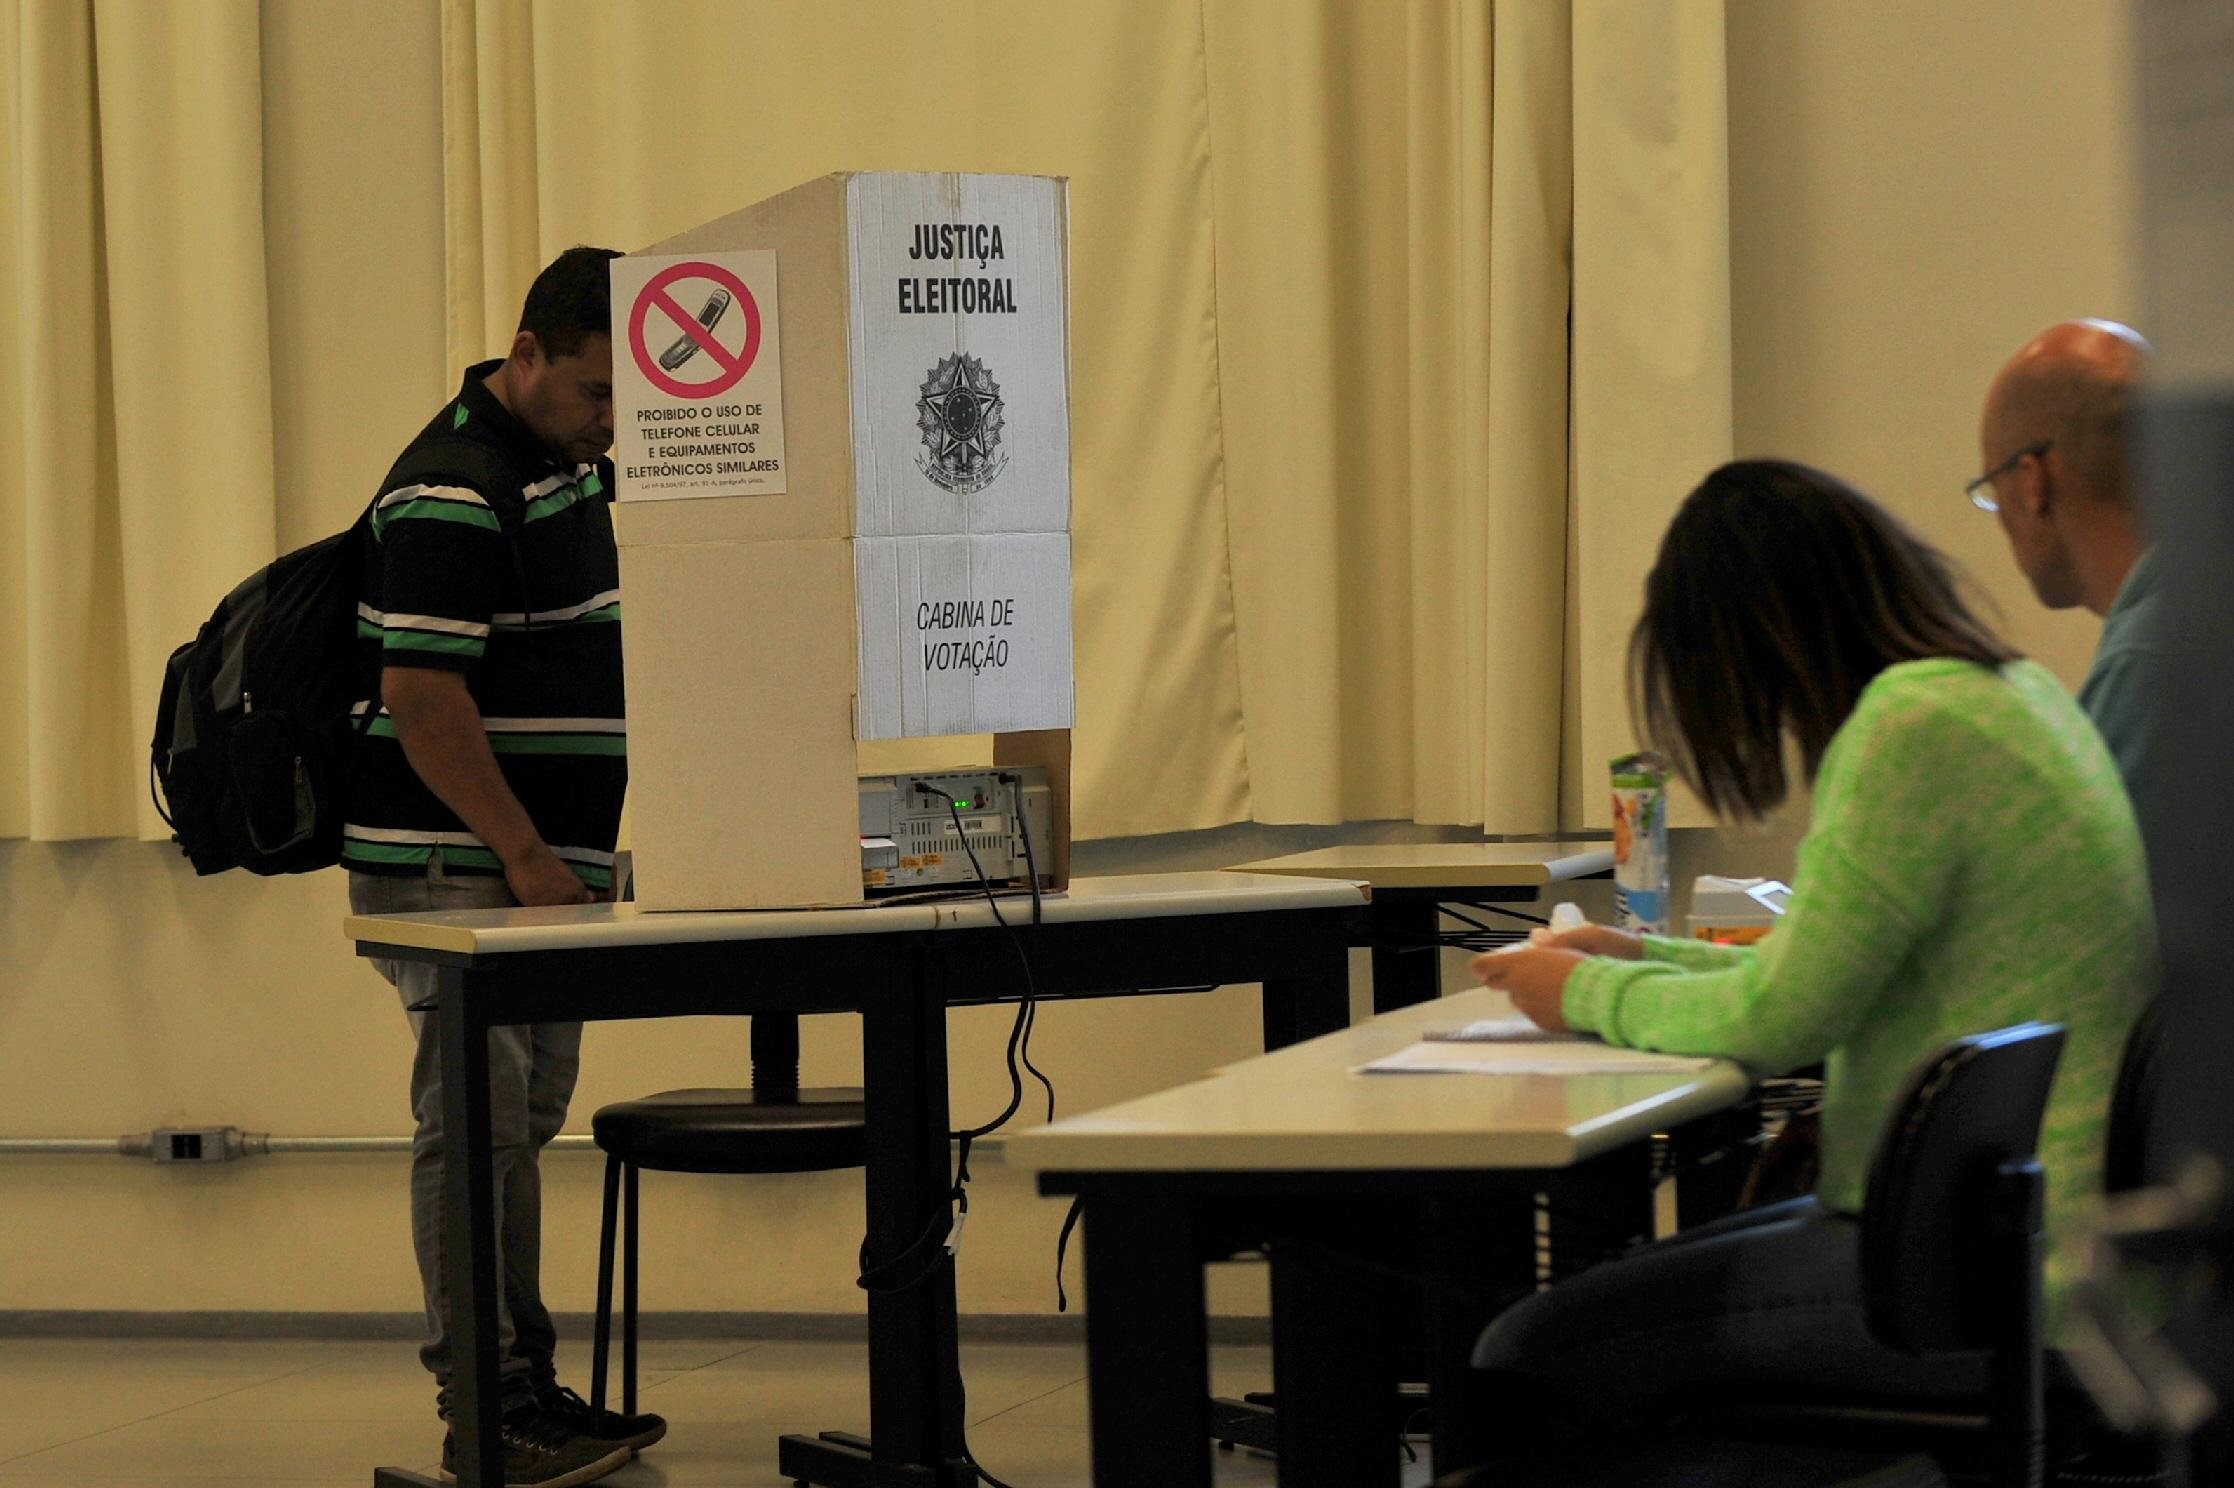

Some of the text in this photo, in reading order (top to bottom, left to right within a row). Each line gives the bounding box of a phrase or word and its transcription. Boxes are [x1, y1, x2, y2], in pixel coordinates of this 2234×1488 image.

[908, 223, 1005, 270] JUSTIÇA
[898, 277, 1018, 314] ELEITORAL
[636, 404, 763, 422] PROIBIDO O USO DE
[641, 423, 760, 441] TELEFONE CELULAR
[648, 442, 756, 459] E EQUIPAMENTOS
[626, 459, 780, 479] ELETRÔNICOS SIMILARES
[917, 598, 1015, 630] CABINA DE
[924, 634, 1009, 676] VOTAÇÃO
